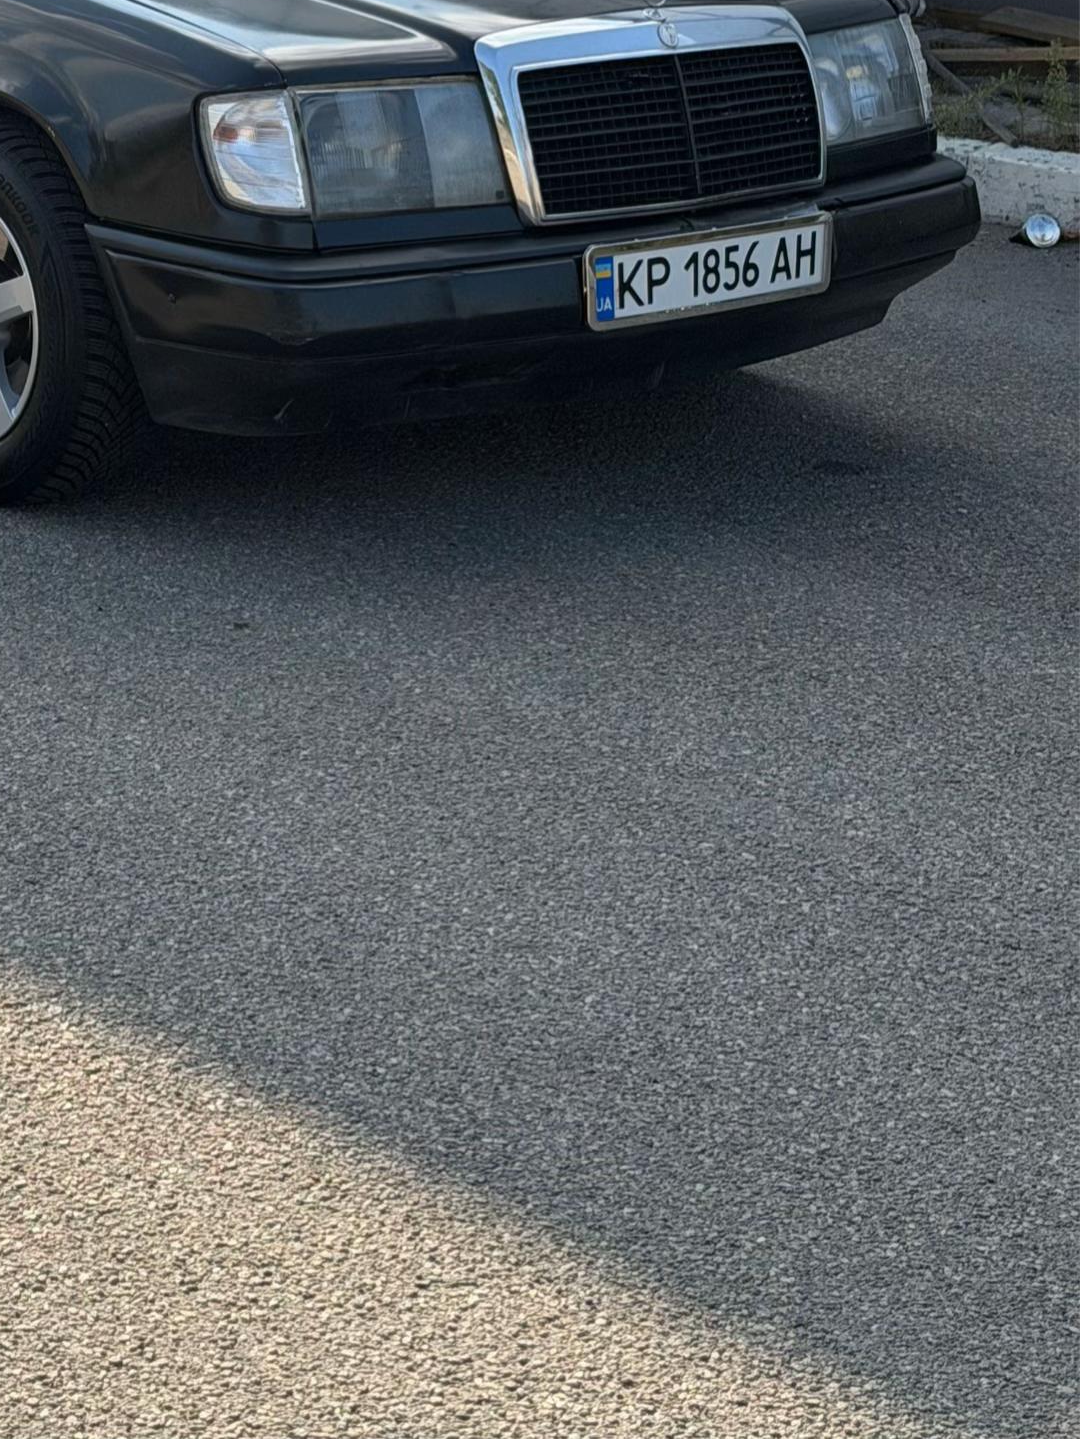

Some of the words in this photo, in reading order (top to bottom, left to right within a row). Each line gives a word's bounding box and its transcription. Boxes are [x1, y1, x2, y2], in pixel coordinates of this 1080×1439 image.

[618, 257, 670, 309] KP
[684, 241, 760, 297] 1856
[770, 231, 817, 283] AH
[596, 296, 613, 312] UA
